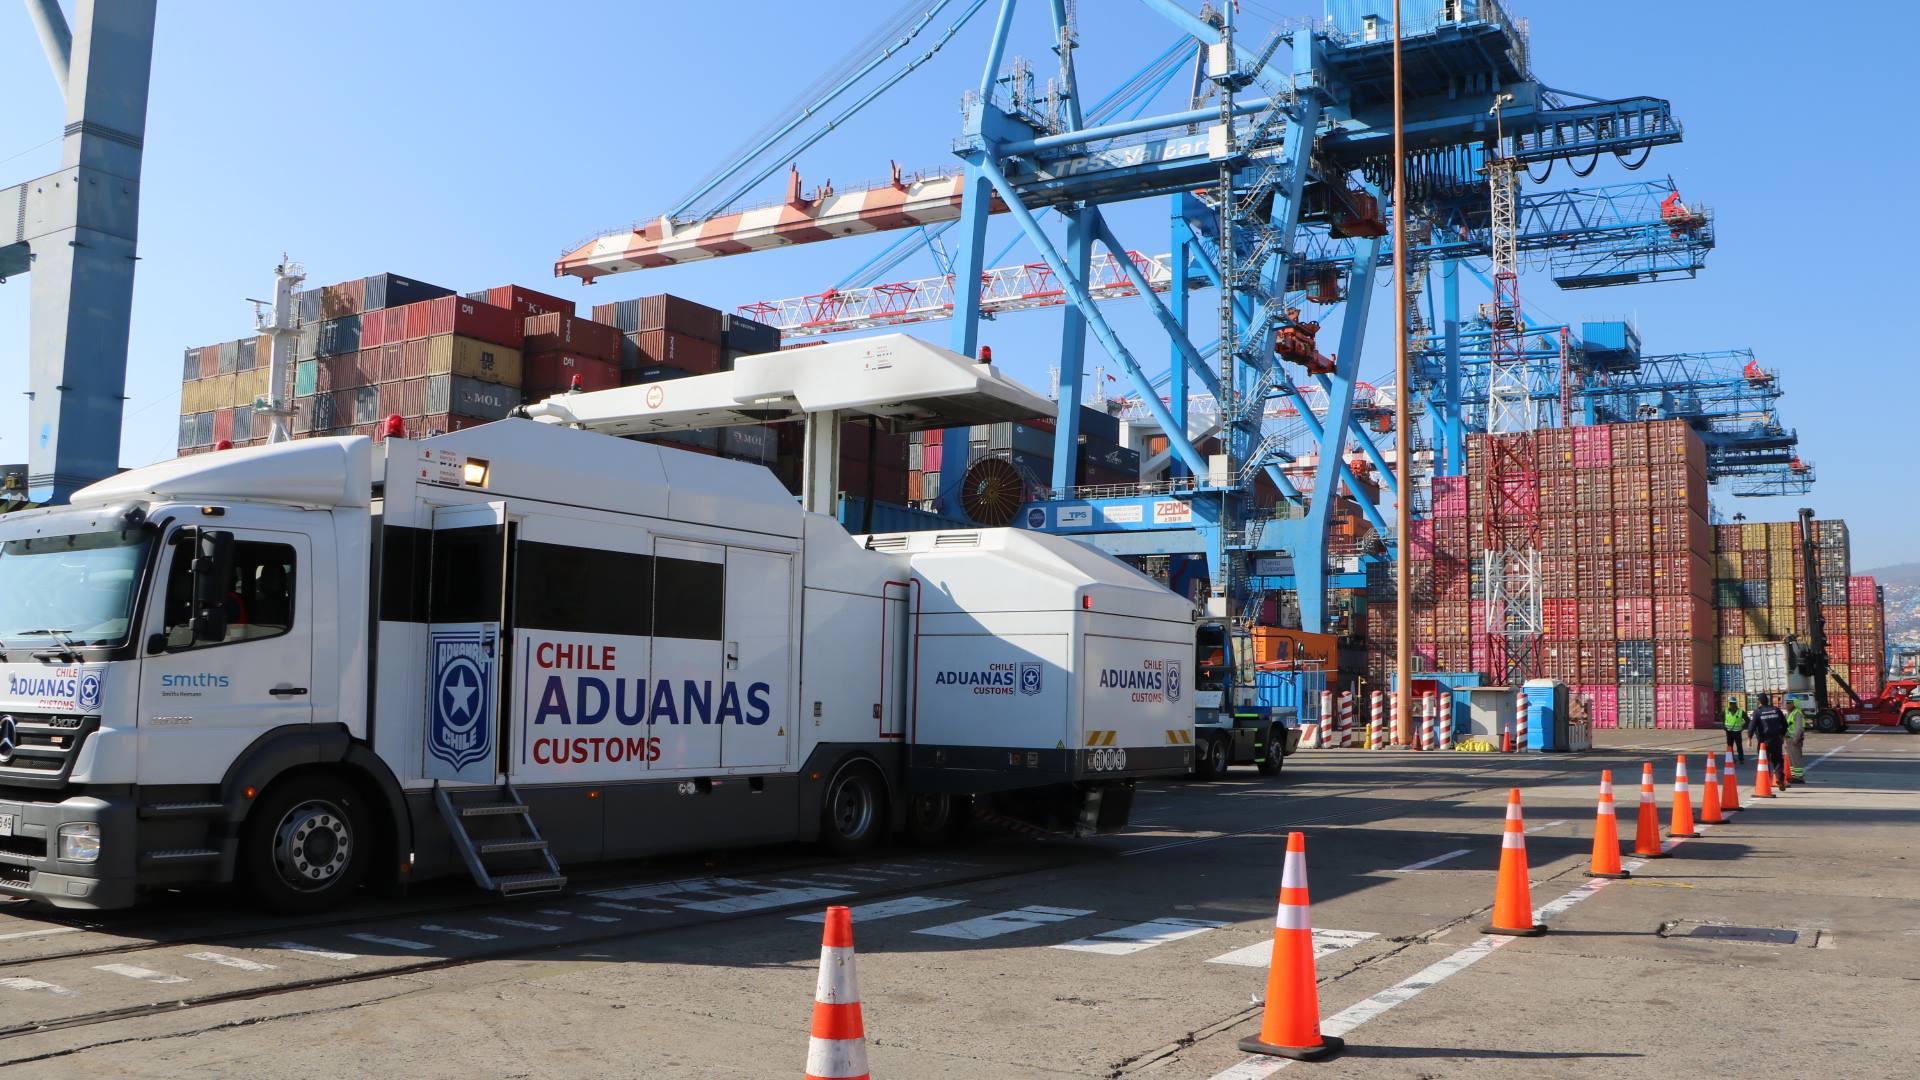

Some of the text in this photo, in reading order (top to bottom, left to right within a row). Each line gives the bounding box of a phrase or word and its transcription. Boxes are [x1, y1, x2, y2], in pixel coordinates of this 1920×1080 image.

[474, 392, 501, 407] MOL
[1068, 511, 1087, 519] TPS
[536, 642, 616, 671] CHILE
[990, 663, 1014, 671] CHILE
[1143, 659, 1162, 670] CHILE
[56, 668, 78, 678] CHILE
[162, 672, 229, 687] smiths
[935, 671, 1014, 685] ADUANAS
[1099, 669, 1162, 689] ADUANAS
[9, 678, 76, 697] ADUANAS
[973, 687, 1014, 695] CUSTOMS
[534, 675, 770, 726] ADUANAS
[1131, 692, 1162, 703] CUSTOMS
[442, 725, 477, 750] CHILE
[533, 737, 661, 765] CUSTOMS
